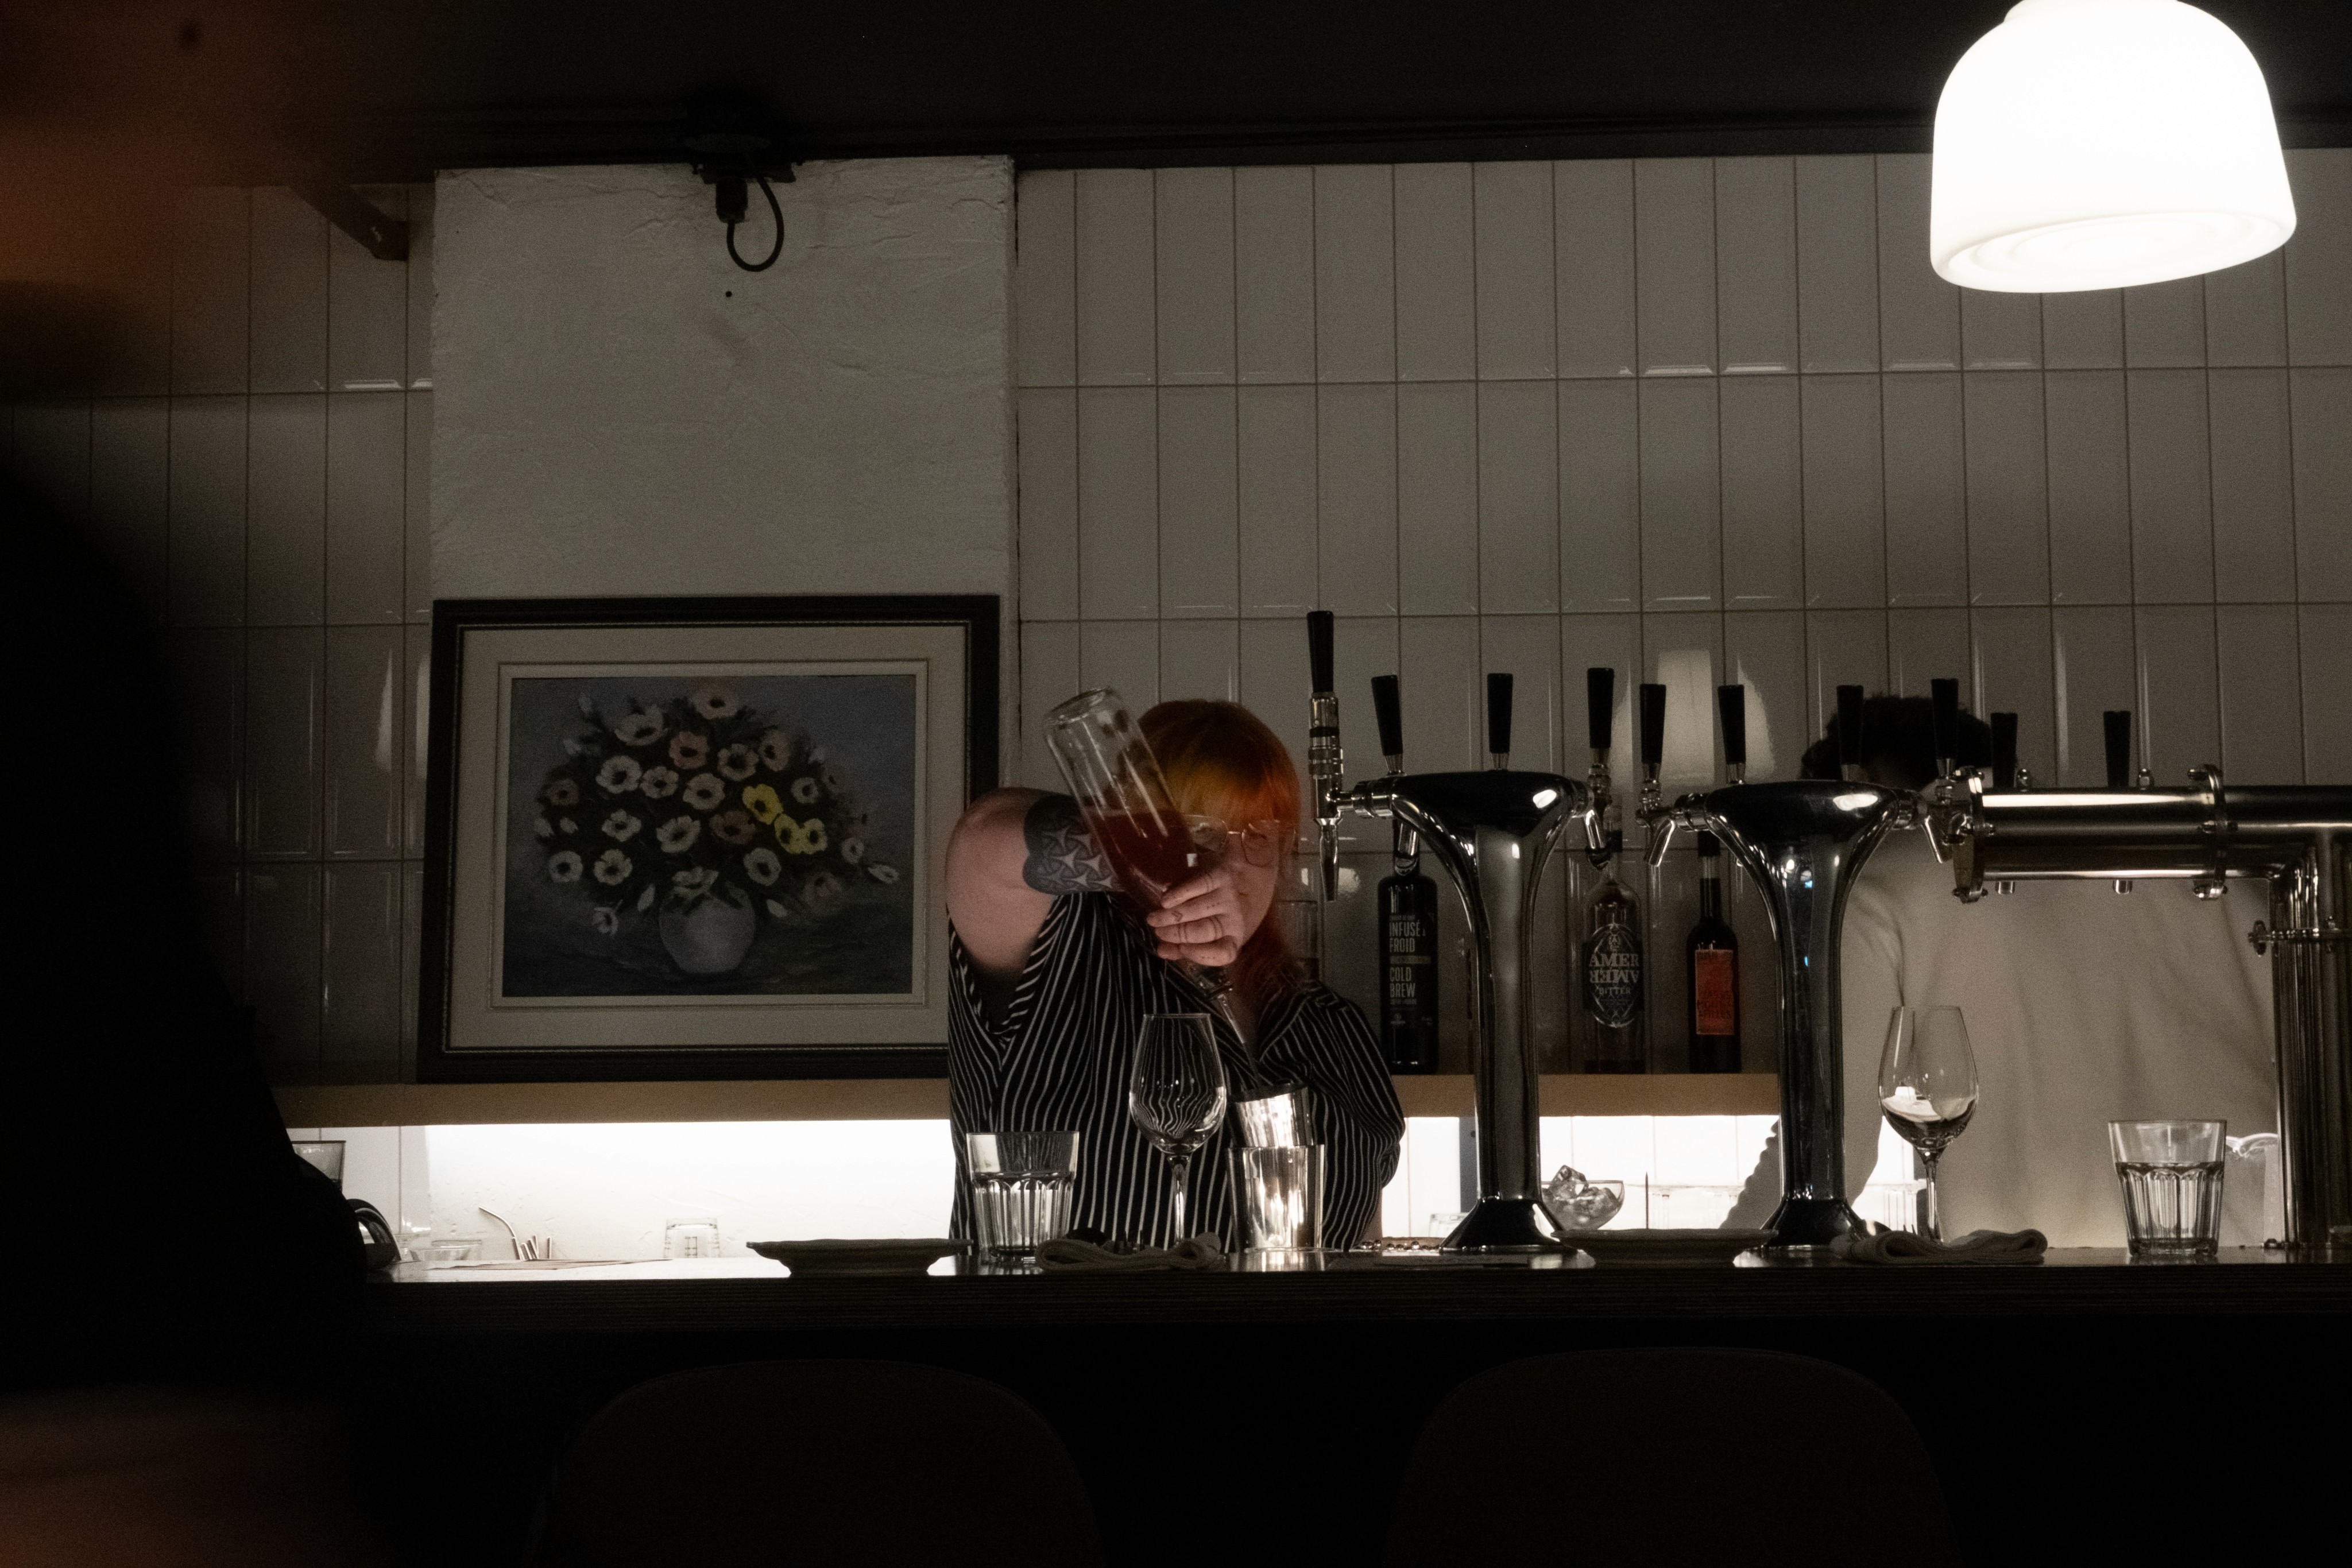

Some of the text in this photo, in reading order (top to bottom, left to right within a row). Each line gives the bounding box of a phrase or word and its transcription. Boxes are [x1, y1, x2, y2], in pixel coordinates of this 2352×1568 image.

[1389, 919, 1420, 937] INFUSÉ
[1389, 938, 1415, 953] FROID
[1588, 953, 1639, 967] AMER
[1389, 966, 1412, 982] COLD
[1390, 982, 1416, 998] BREW
[1599, 986, 1632, 996] BITTER
